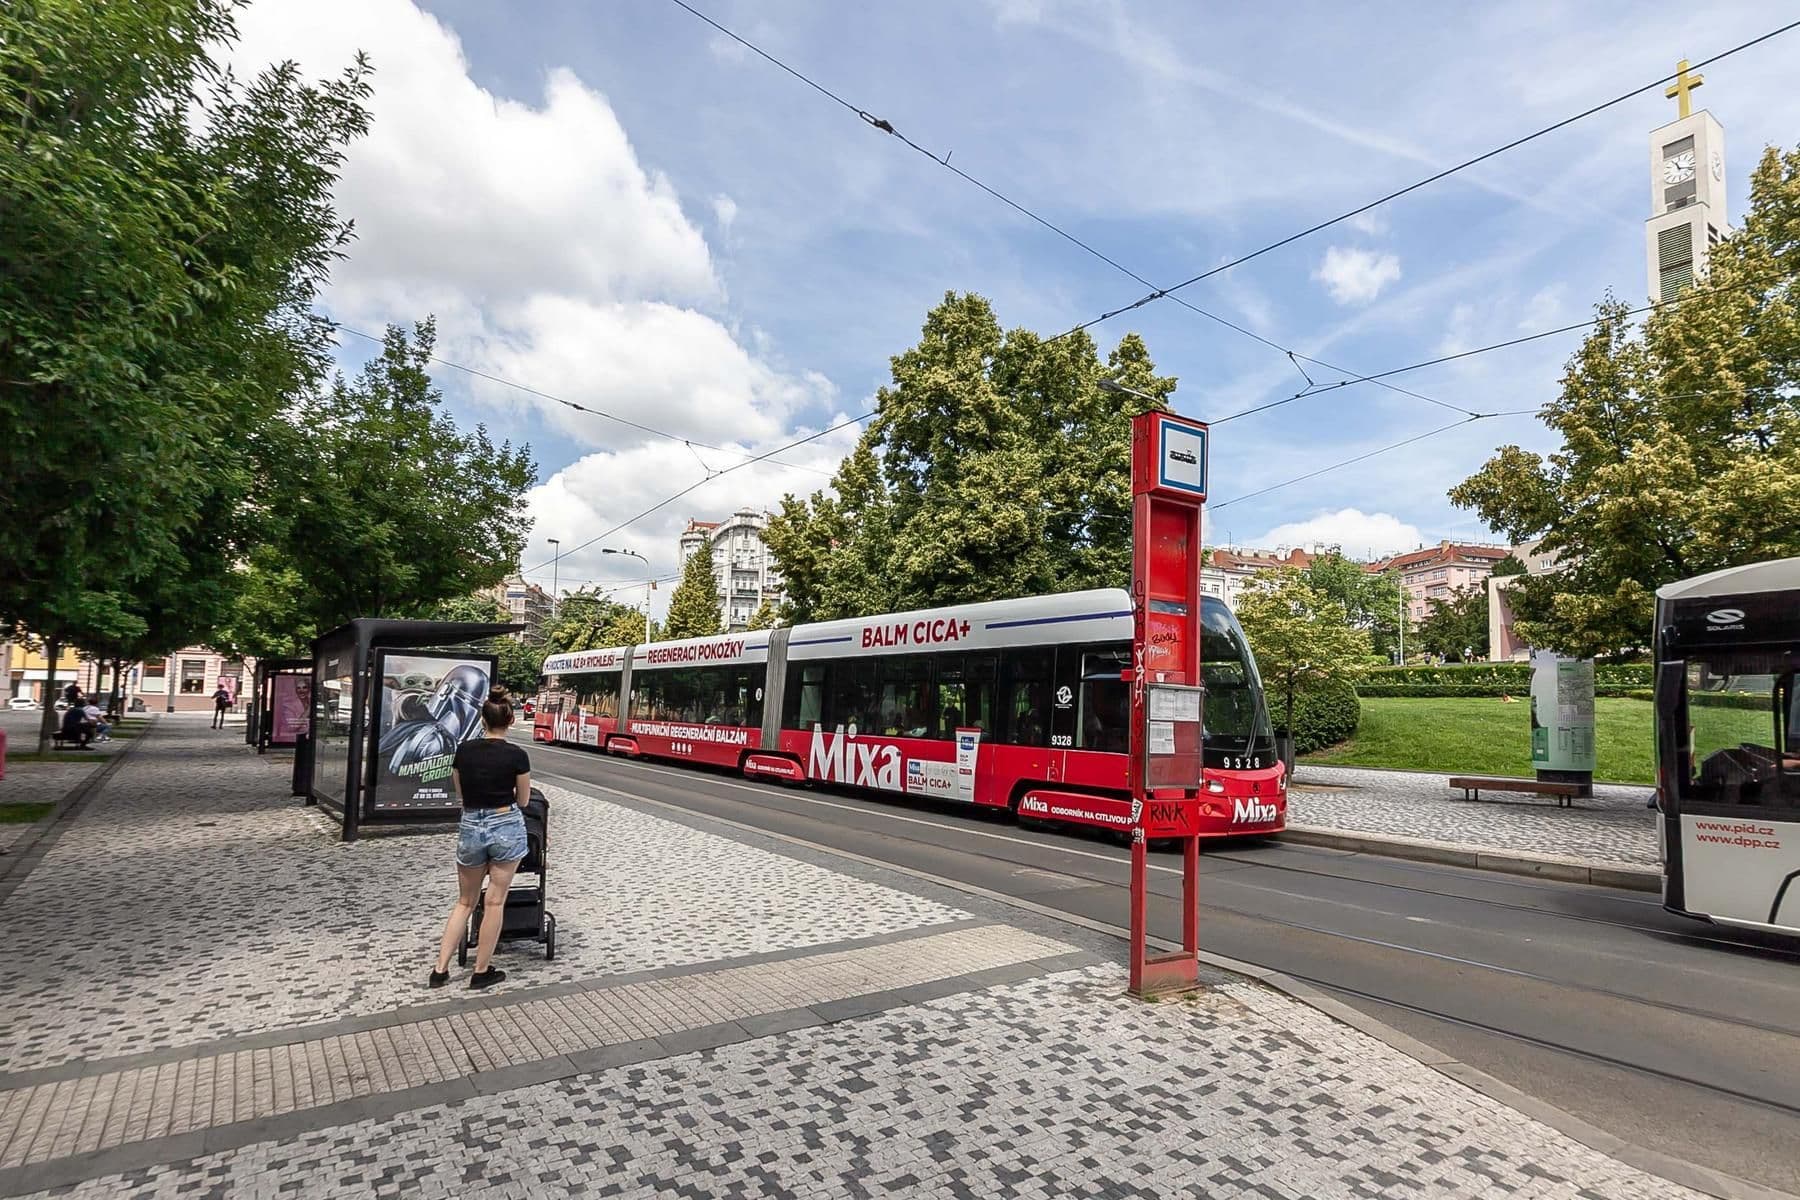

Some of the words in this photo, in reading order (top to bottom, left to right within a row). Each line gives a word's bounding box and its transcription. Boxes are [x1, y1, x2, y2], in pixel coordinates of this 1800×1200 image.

[862, 624, 908, 648] BALM
[913, 618, 971, 644] CICA+
[648, 645, 697, 664] REGENERACI
[698, 639, 745, 659] POKOŽKY
[553, 711, 578, 742] Mixa
[631, 722, 670, 737] MULTIFUNKČNÍ
[670, 725, 716, 741] REGENERAČNÍ
[716, 728, 747, 745] BALZÁM
[1051, 735, 1072, 746] 9328
[398, 754, 456, 776] MANDALORI
[808, 723, 903, 791] Mixa
[1223, 757, 1260, 769] 9328
[422, 766, 454, 783] GROGU
[908, 775, 927, 786] BALM
[929, 778, 951, 790] CICA+
[1022, 796, 1048, 812] Mixa
[1051, 806, 1084, 819] ODBORNÍK
[1084, 811, 1095, 820] NA
[1095, 813, 1127, 825] CITLIVOU
[1232, 797, 1277, 823] Mixa
[1696, 822, 1776, 836] www.pid.cz
[1696, 835, 1781, 849] www.dpp.cz
